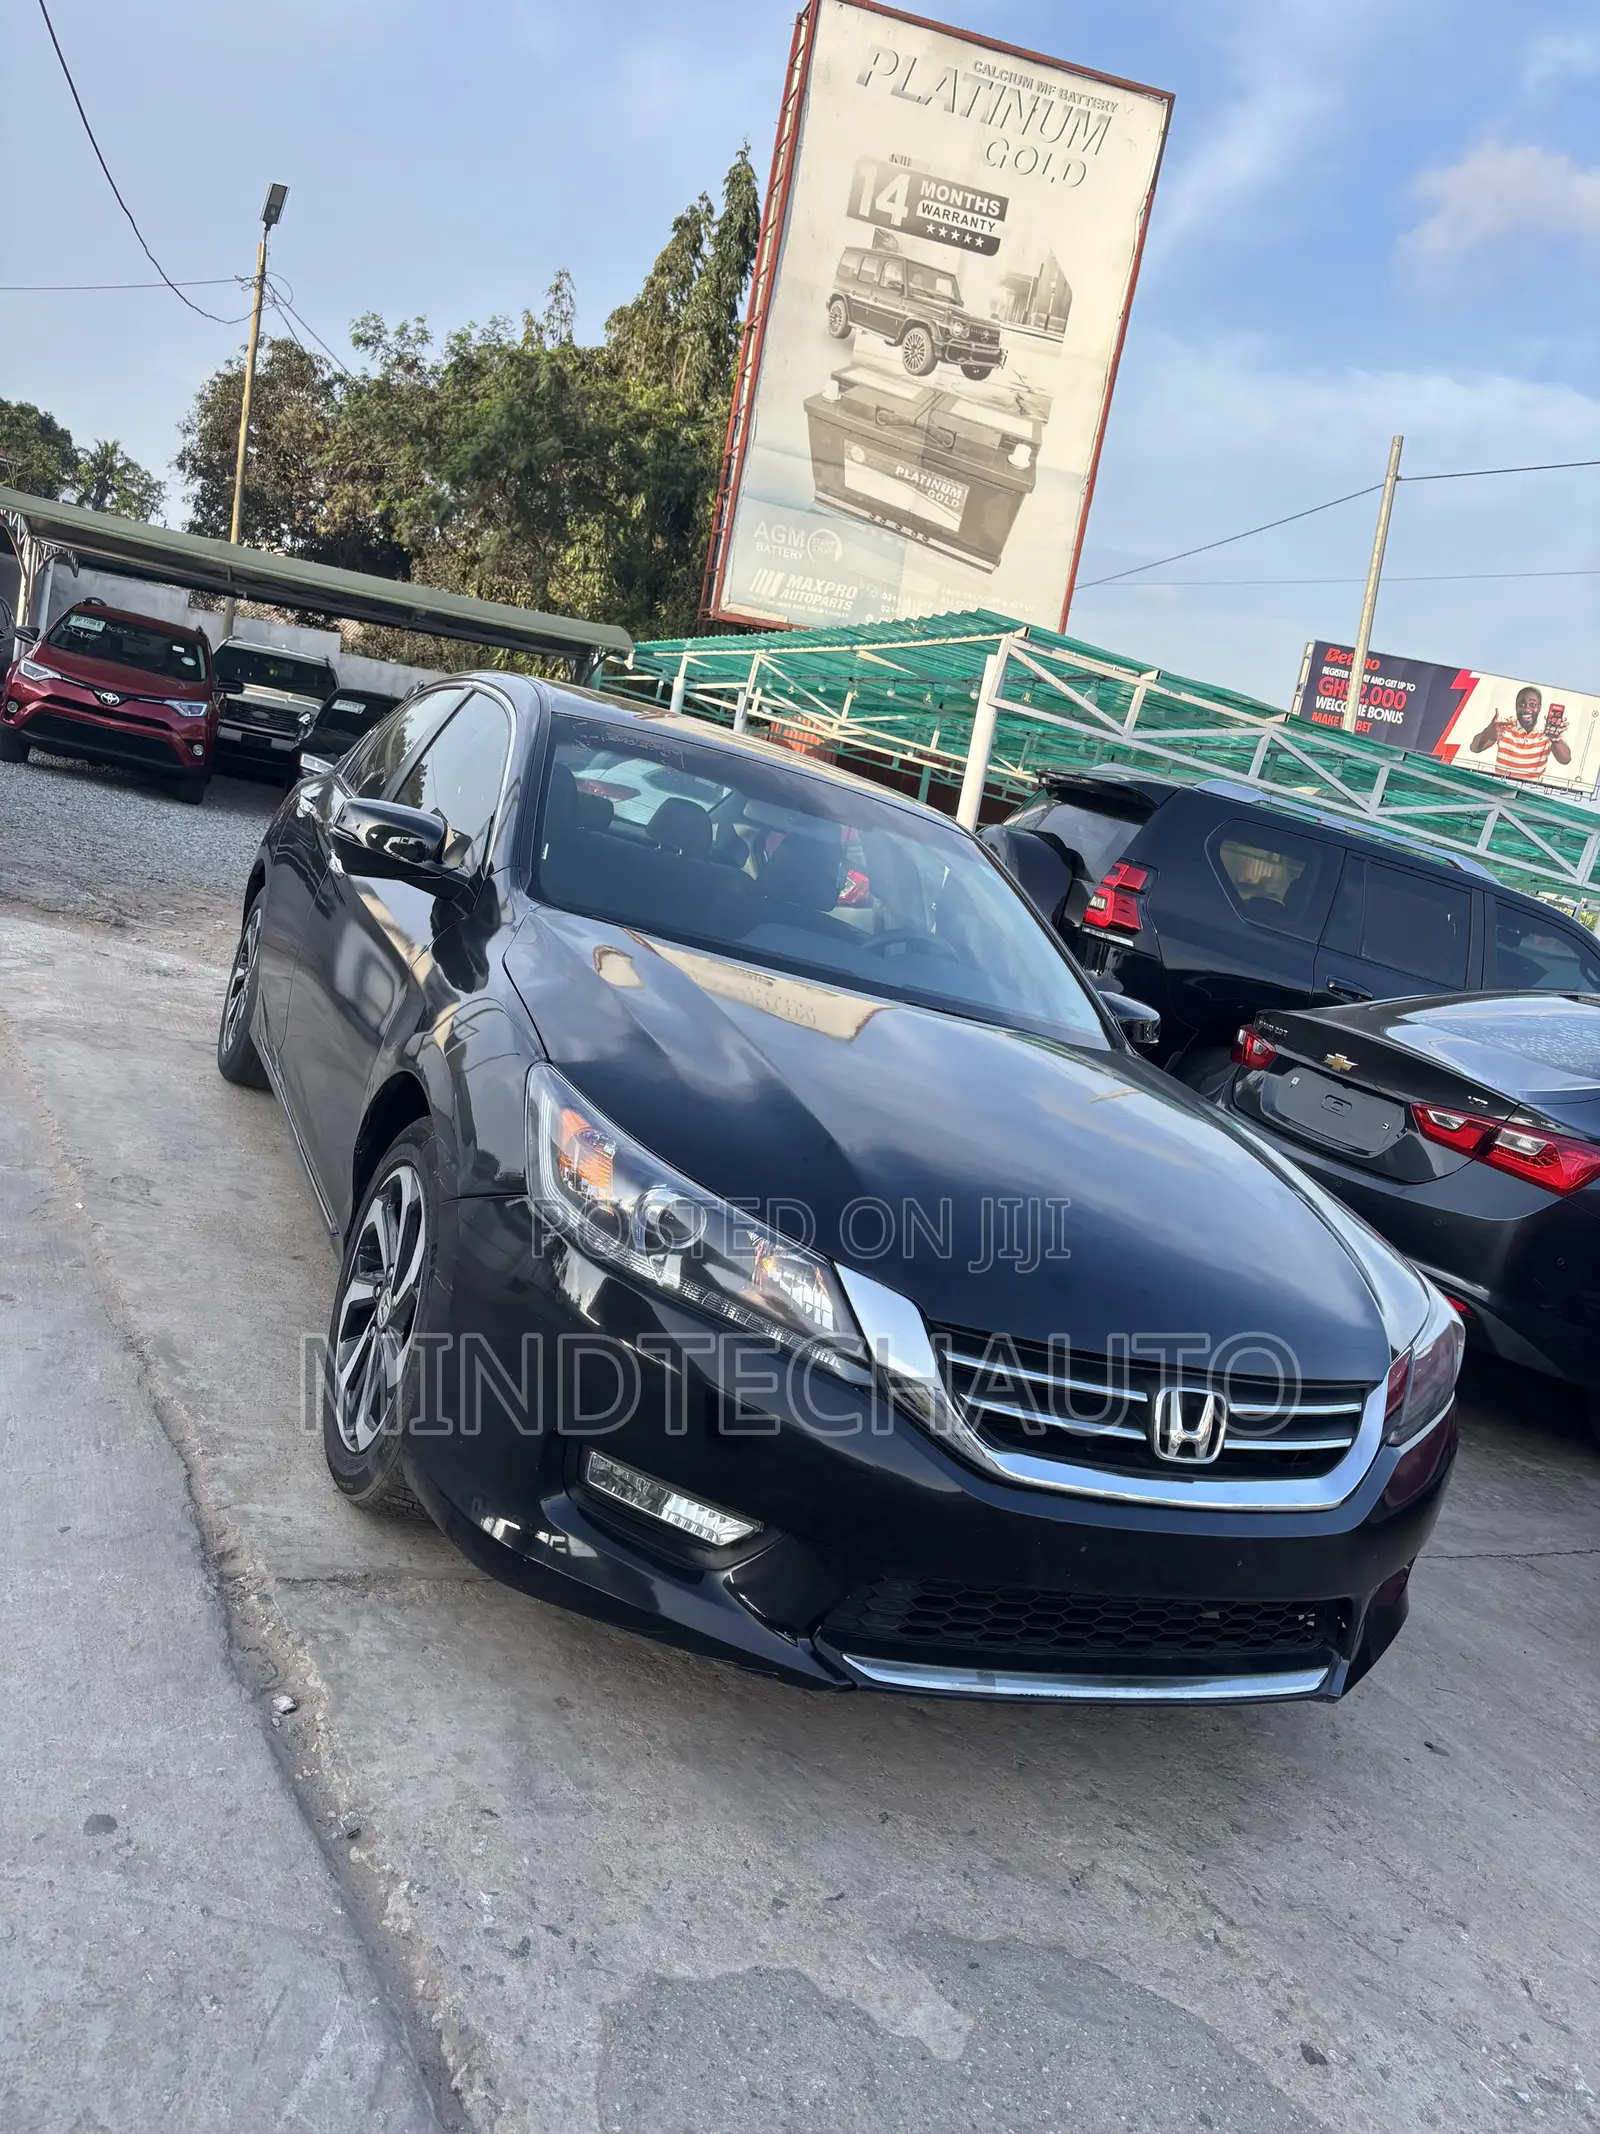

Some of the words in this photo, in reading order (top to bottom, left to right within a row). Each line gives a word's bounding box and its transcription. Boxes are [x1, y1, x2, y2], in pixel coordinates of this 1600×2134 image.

[855, 44, 1113, 156] PLATINUM
[972, 60, 1034, 89] CALCIUM
[1036, 79, 1057, 98] MF
[1058, 84, 1119, 114] BATTERY
[985, 137, 1088, 189] GOLD
[859, 162, 910, 227] 14
[920, 180, 1001, 218] MONTHS
[921, 202, 996, 233] WARRANTY
[895, 466, 963, 499] PLATINUM
[927, 489, 960, 509] GOLD
[754, 520, 805, 548] AGM
[756, 541, 805, 560] BATTERY
[780, 588, 854, 612] AUTOPARTS
[786, 574, 858, 600] MAXPRO
[1322, 666, 1349, 679] REGISTER
[1370, 676, 1385, 687] AND
[1385, 678, 1397, 689] GET
[1397, 680, 1406, 689] UP
[1406, 682, 1416, 692] TO
[1311, 711, 1339, 727] MAKE
[1356, 720, 1373, 733] BET
[1367, 706, 1405, 725] BONUS
